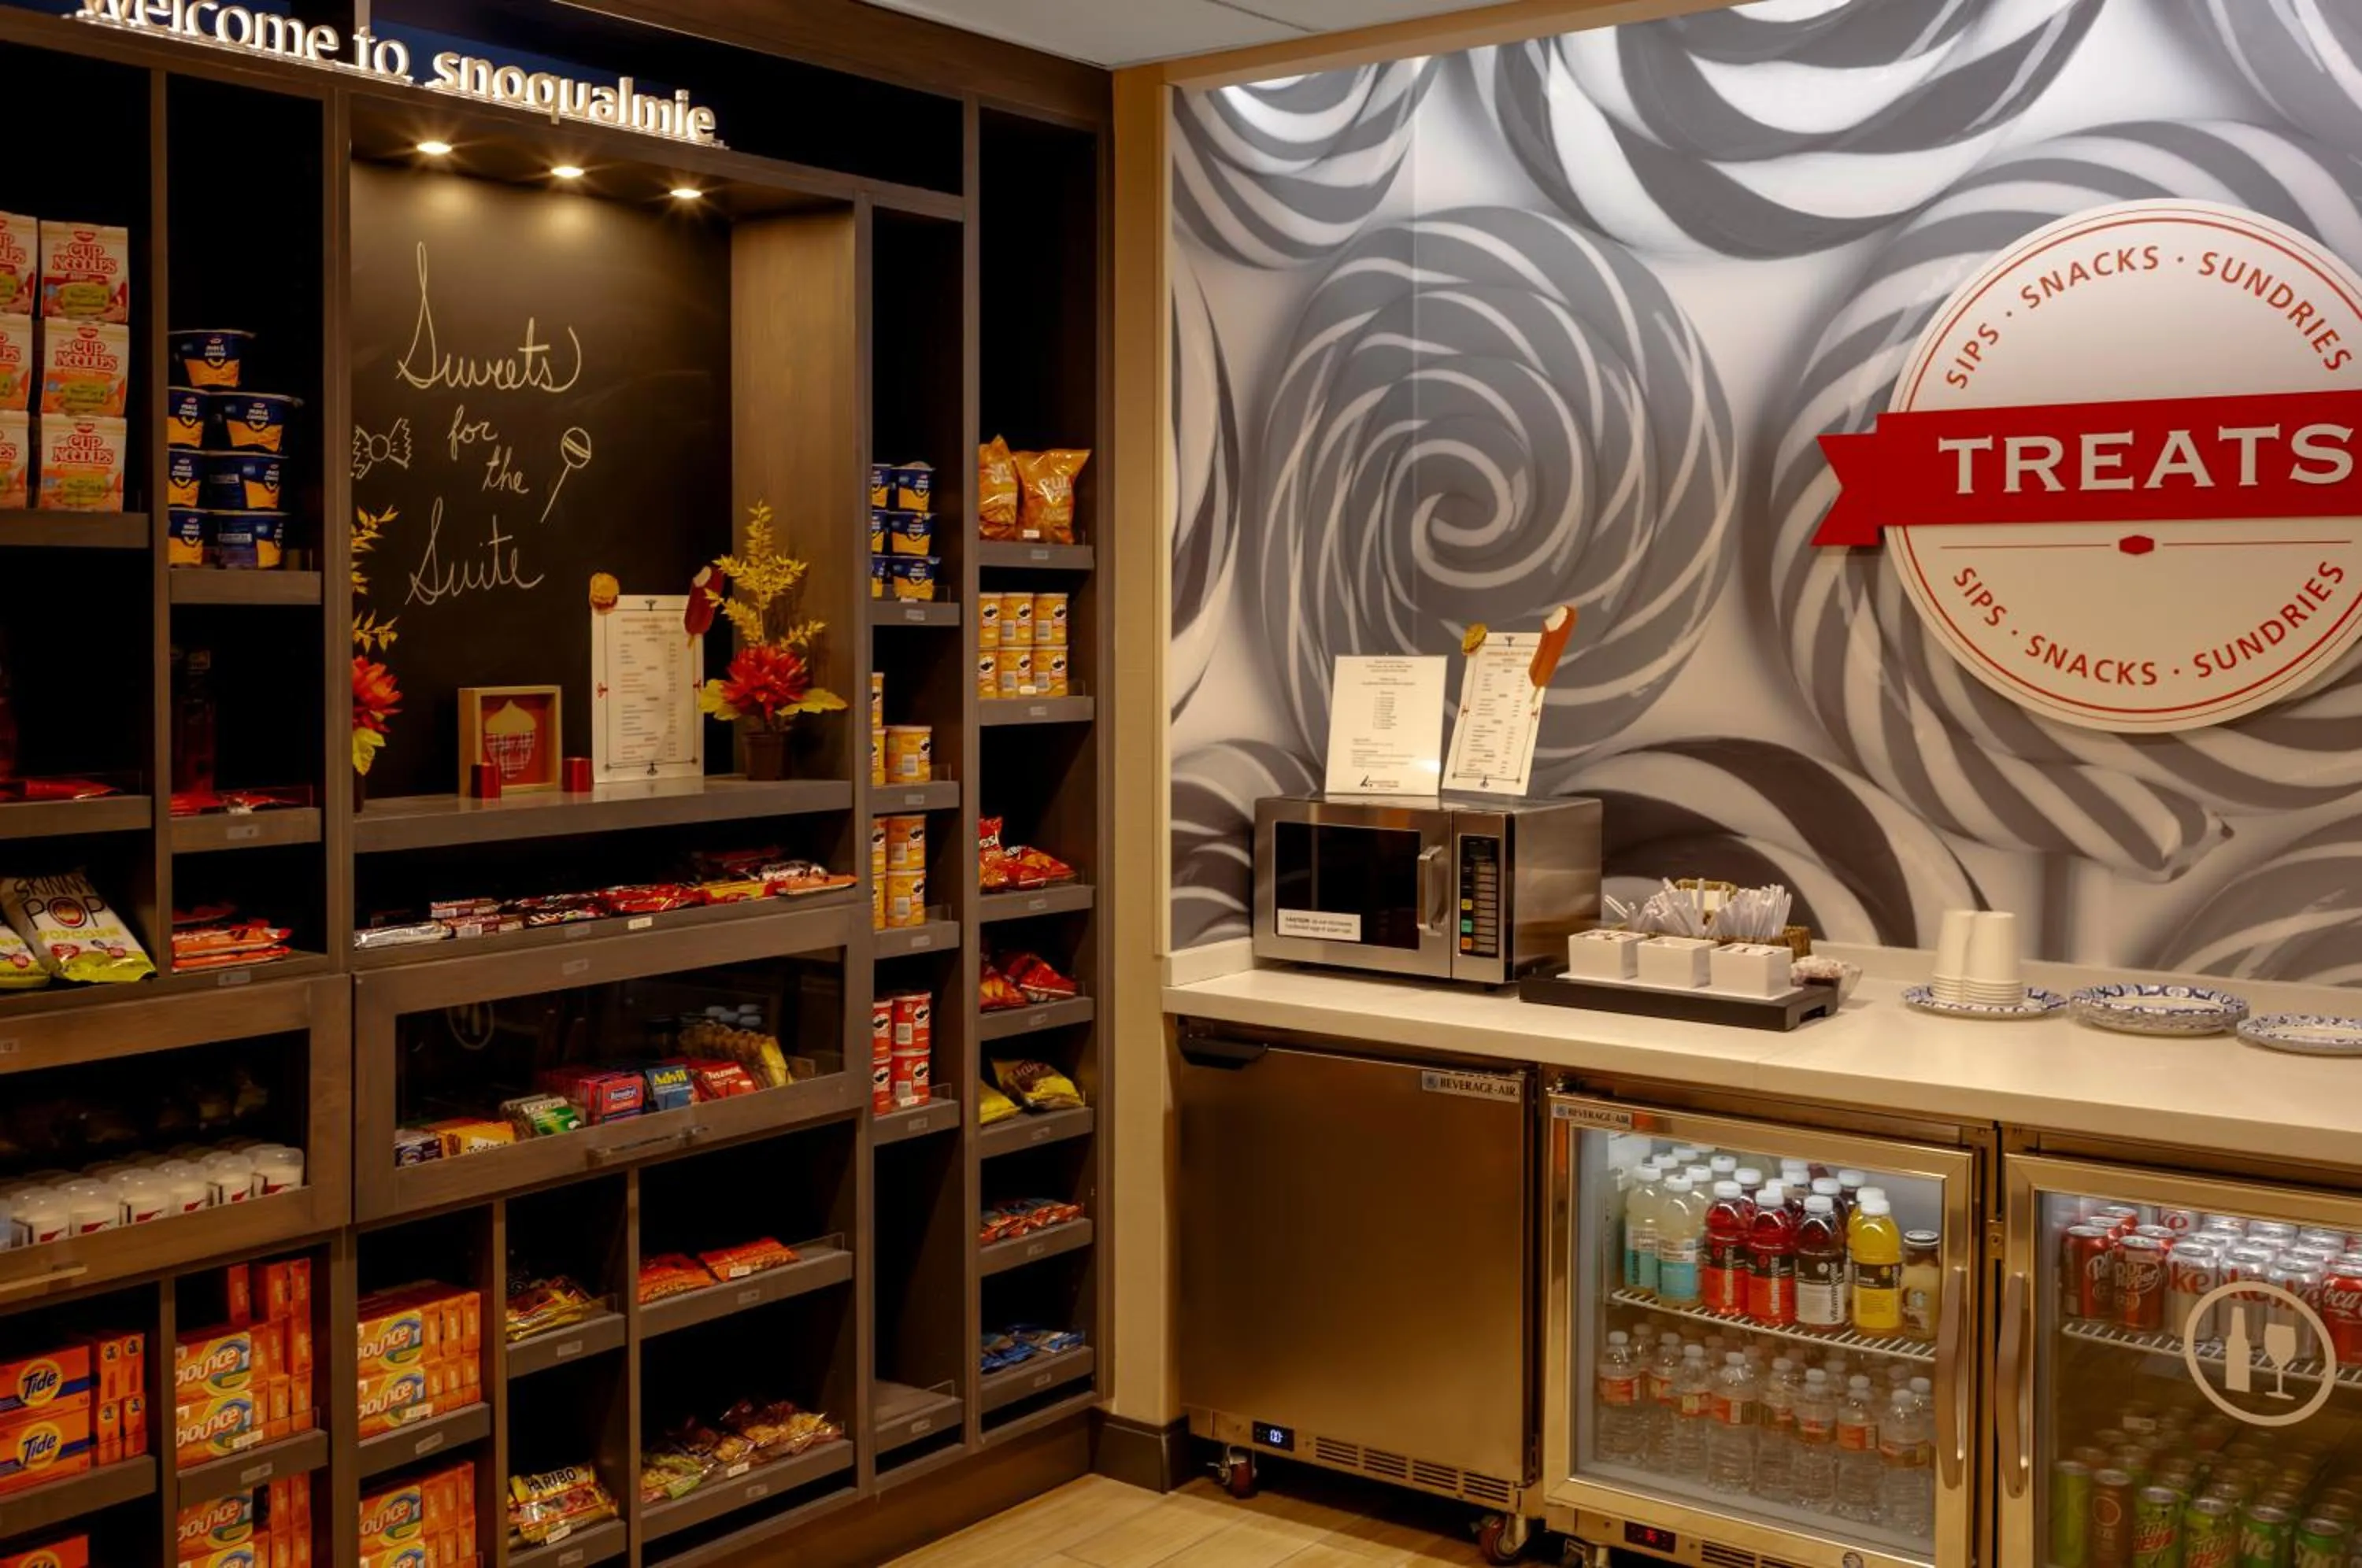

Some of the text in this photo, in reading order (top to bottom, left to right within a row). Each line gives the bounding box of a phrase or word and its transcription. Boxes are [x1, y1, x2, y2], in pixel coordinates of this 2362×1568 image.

[353, 26, 410, 76] to
[431, 50, 718, 143] snoqualmie
[395, 241, 583, 393] Sweets
[1946, 246, 2353, 389] SIPS SNACKS SUNDRIES
[448, 405, 498, 460] for
[482, 445, 530, 494] the
[1938, 423, 2355, 494] TREATS
[404, 497, 545, 605] Suite
[1953, 560, 2345, 686] SIPS SNACKS SUNDRIES
[13, 872, 94, 900] SKINNY
[22, 896, 106, 930] POP
[654, 1069, 687, 1085] Advil
[1439, 1076, 1516, 1096] BEVERAGE-AIR
[23, 1369, 57, 1400] Tide
[23, 1433, 57, 1465] Tide
[528, 1468, 576, 1492] HARIBO
